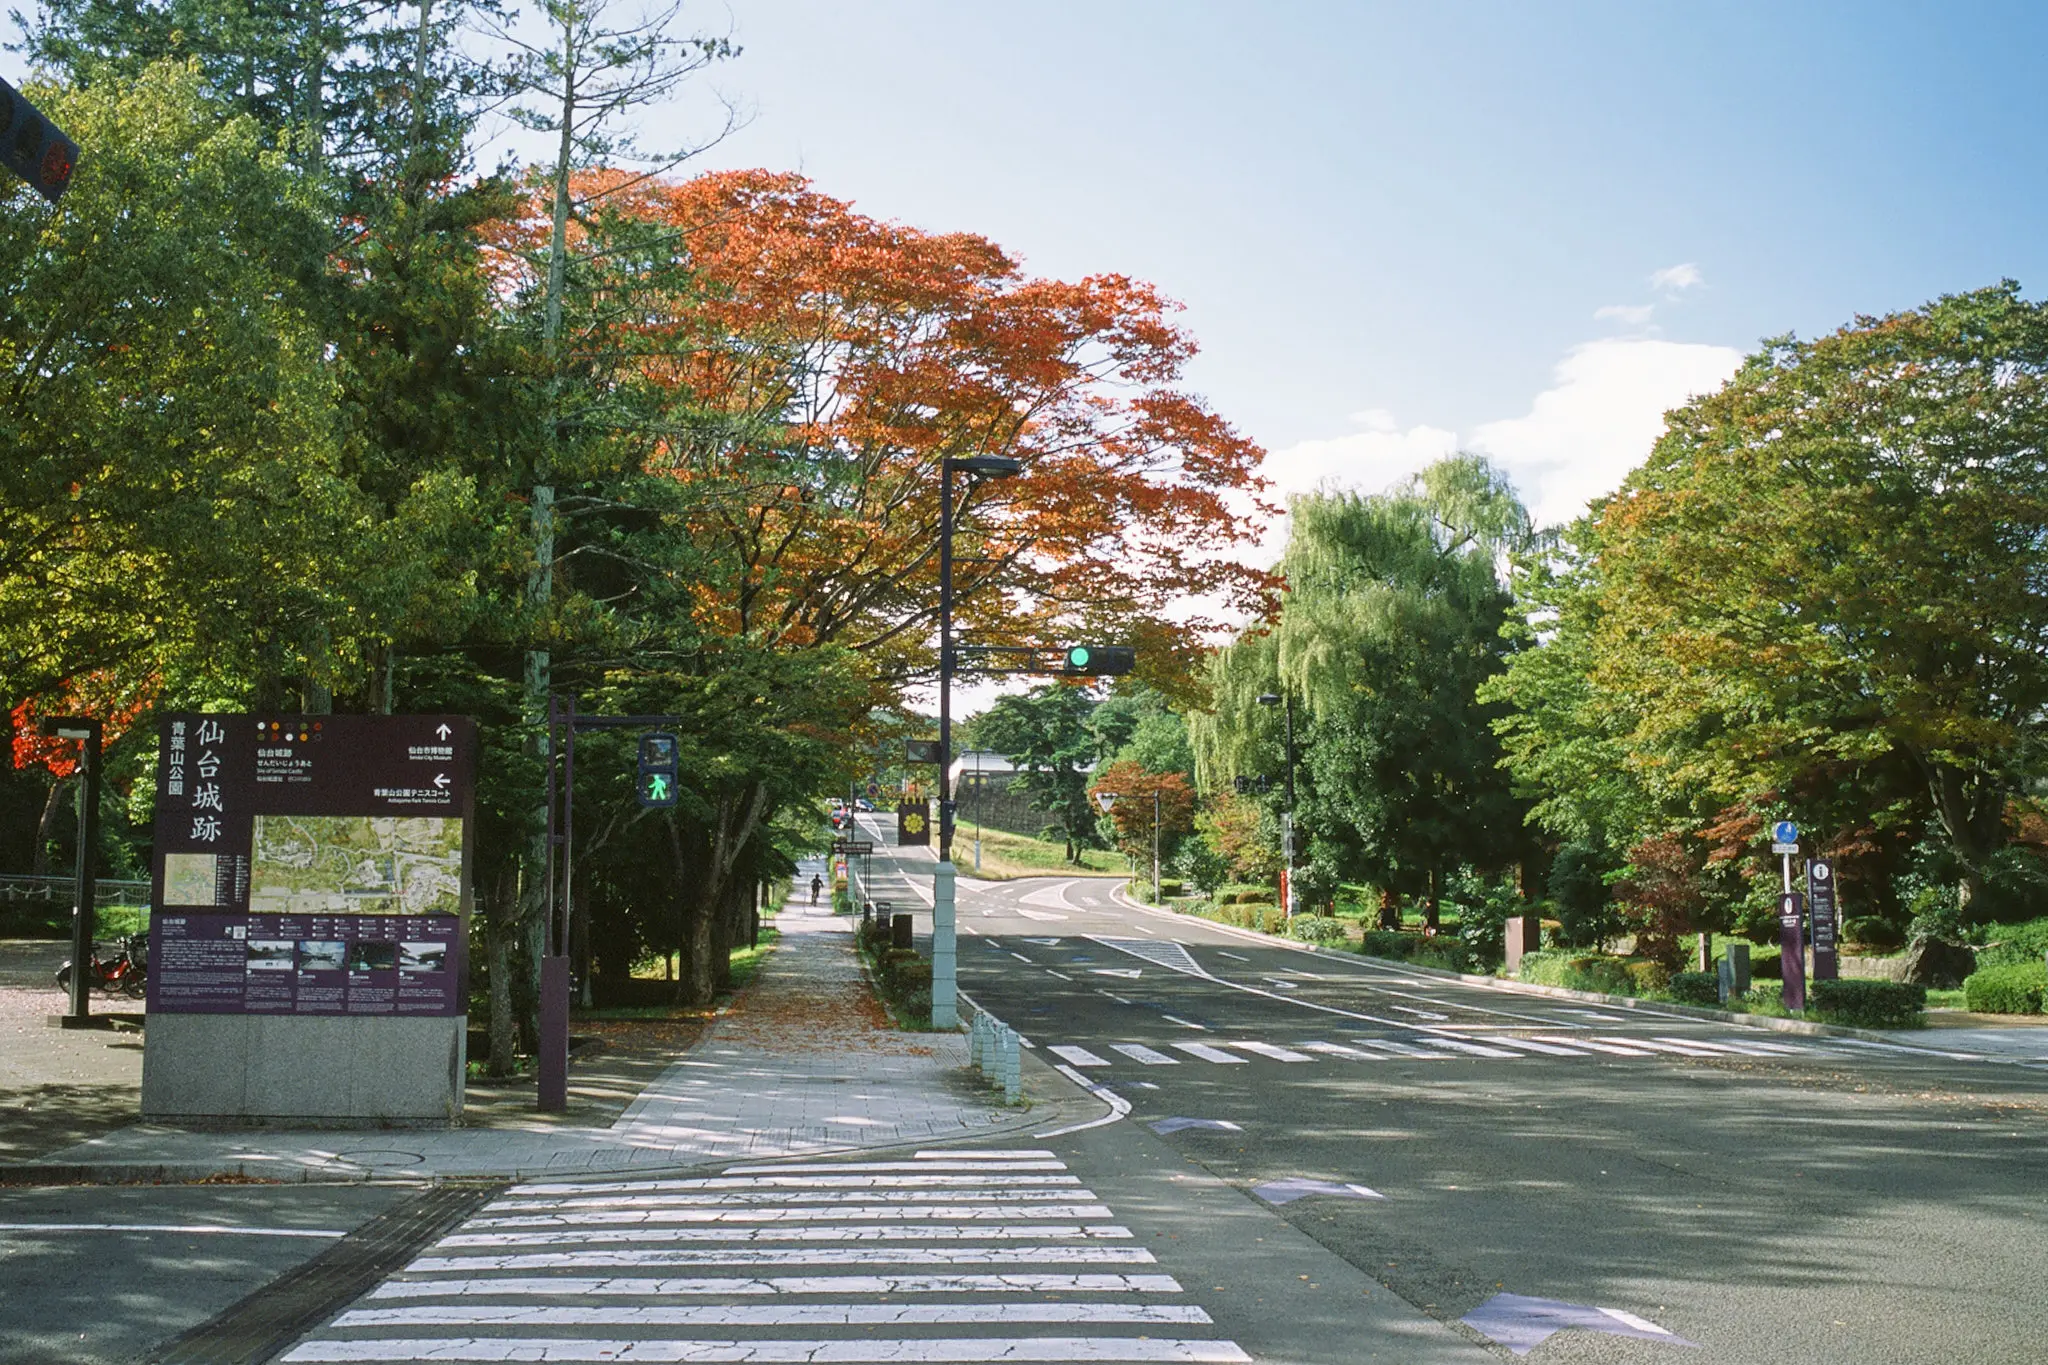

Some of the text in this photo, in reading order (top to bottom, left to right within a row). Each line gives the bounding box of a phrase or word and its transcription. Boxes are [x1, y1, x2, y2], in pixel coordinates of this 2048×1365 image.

[168, 720, 187, 796] 青葉山公園
[257, 748, 293, 758] 仙台城跡
[189, 718, 225, 843] 仙台城跡
[373, 788, 451, 797] 青葉山公園テニスコート
